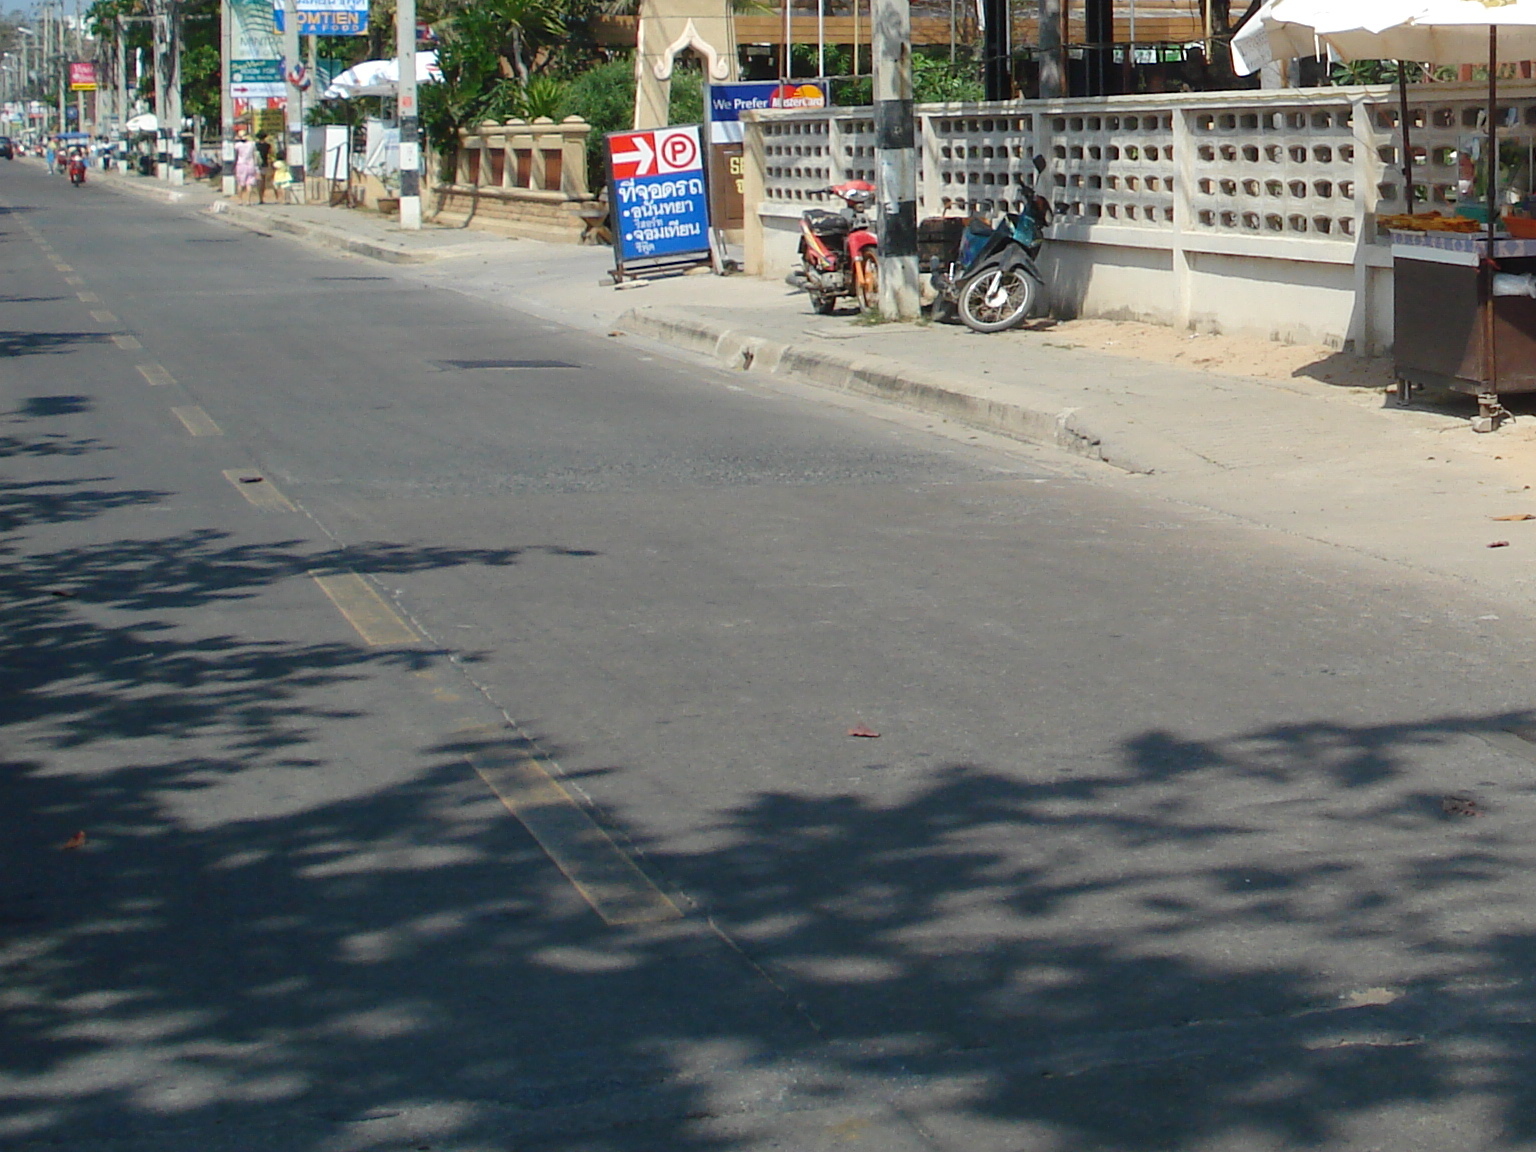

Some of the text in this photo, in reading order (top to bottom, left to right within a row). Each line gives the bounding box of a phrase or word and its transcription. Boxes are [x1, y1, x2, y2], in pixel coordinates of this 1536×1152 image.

[297, 11, 359, 25] OMTIEN
[713, 98, 731, 110] We
[734, 97, 768, 109] Prefer
[670, 139, 687, 162] P
[619, 177, 704, 203] ที่จอดรถ
[633, 220, 700, 242] จอมเทียน
